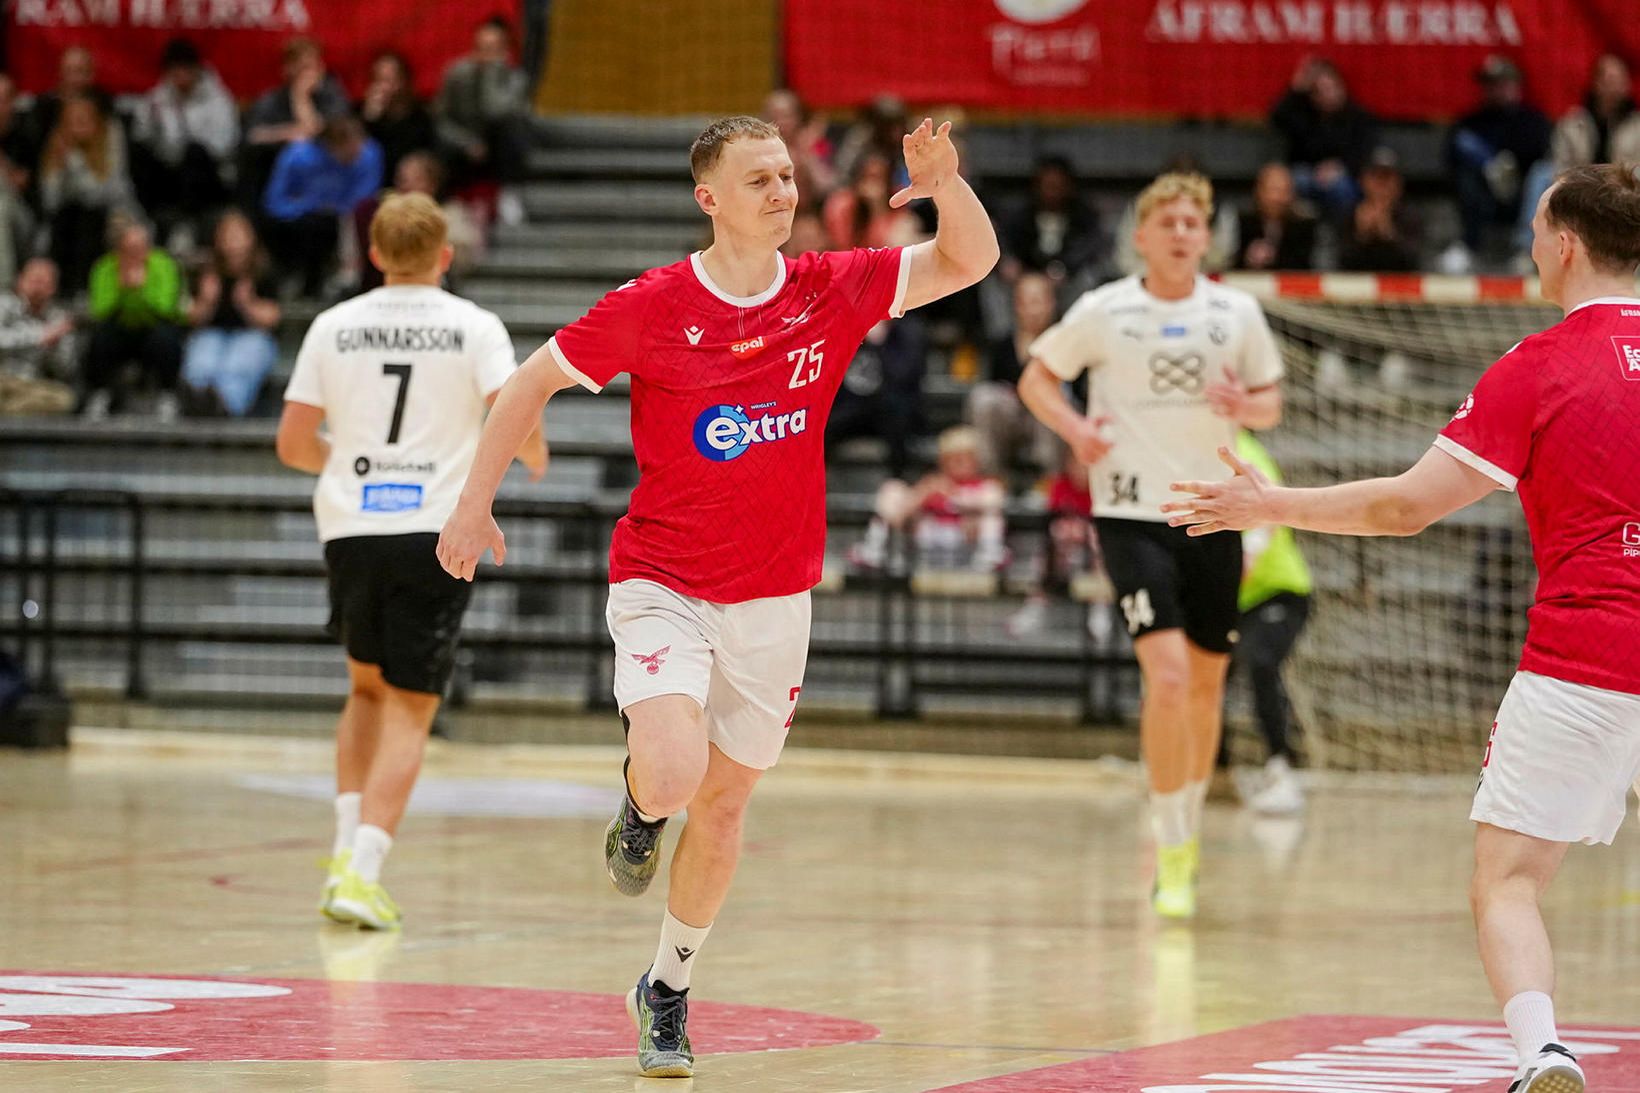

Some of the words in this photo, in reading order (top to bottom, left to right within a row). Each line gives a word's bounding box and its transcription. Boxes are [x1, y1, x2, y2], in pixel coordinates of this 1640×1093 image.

[336, 326, 465, 352] GUNNARSSON
[787, 339, 826, 389] 25
[382, 364, 412, 444] 7
[705, 408, 808, 451] extra
